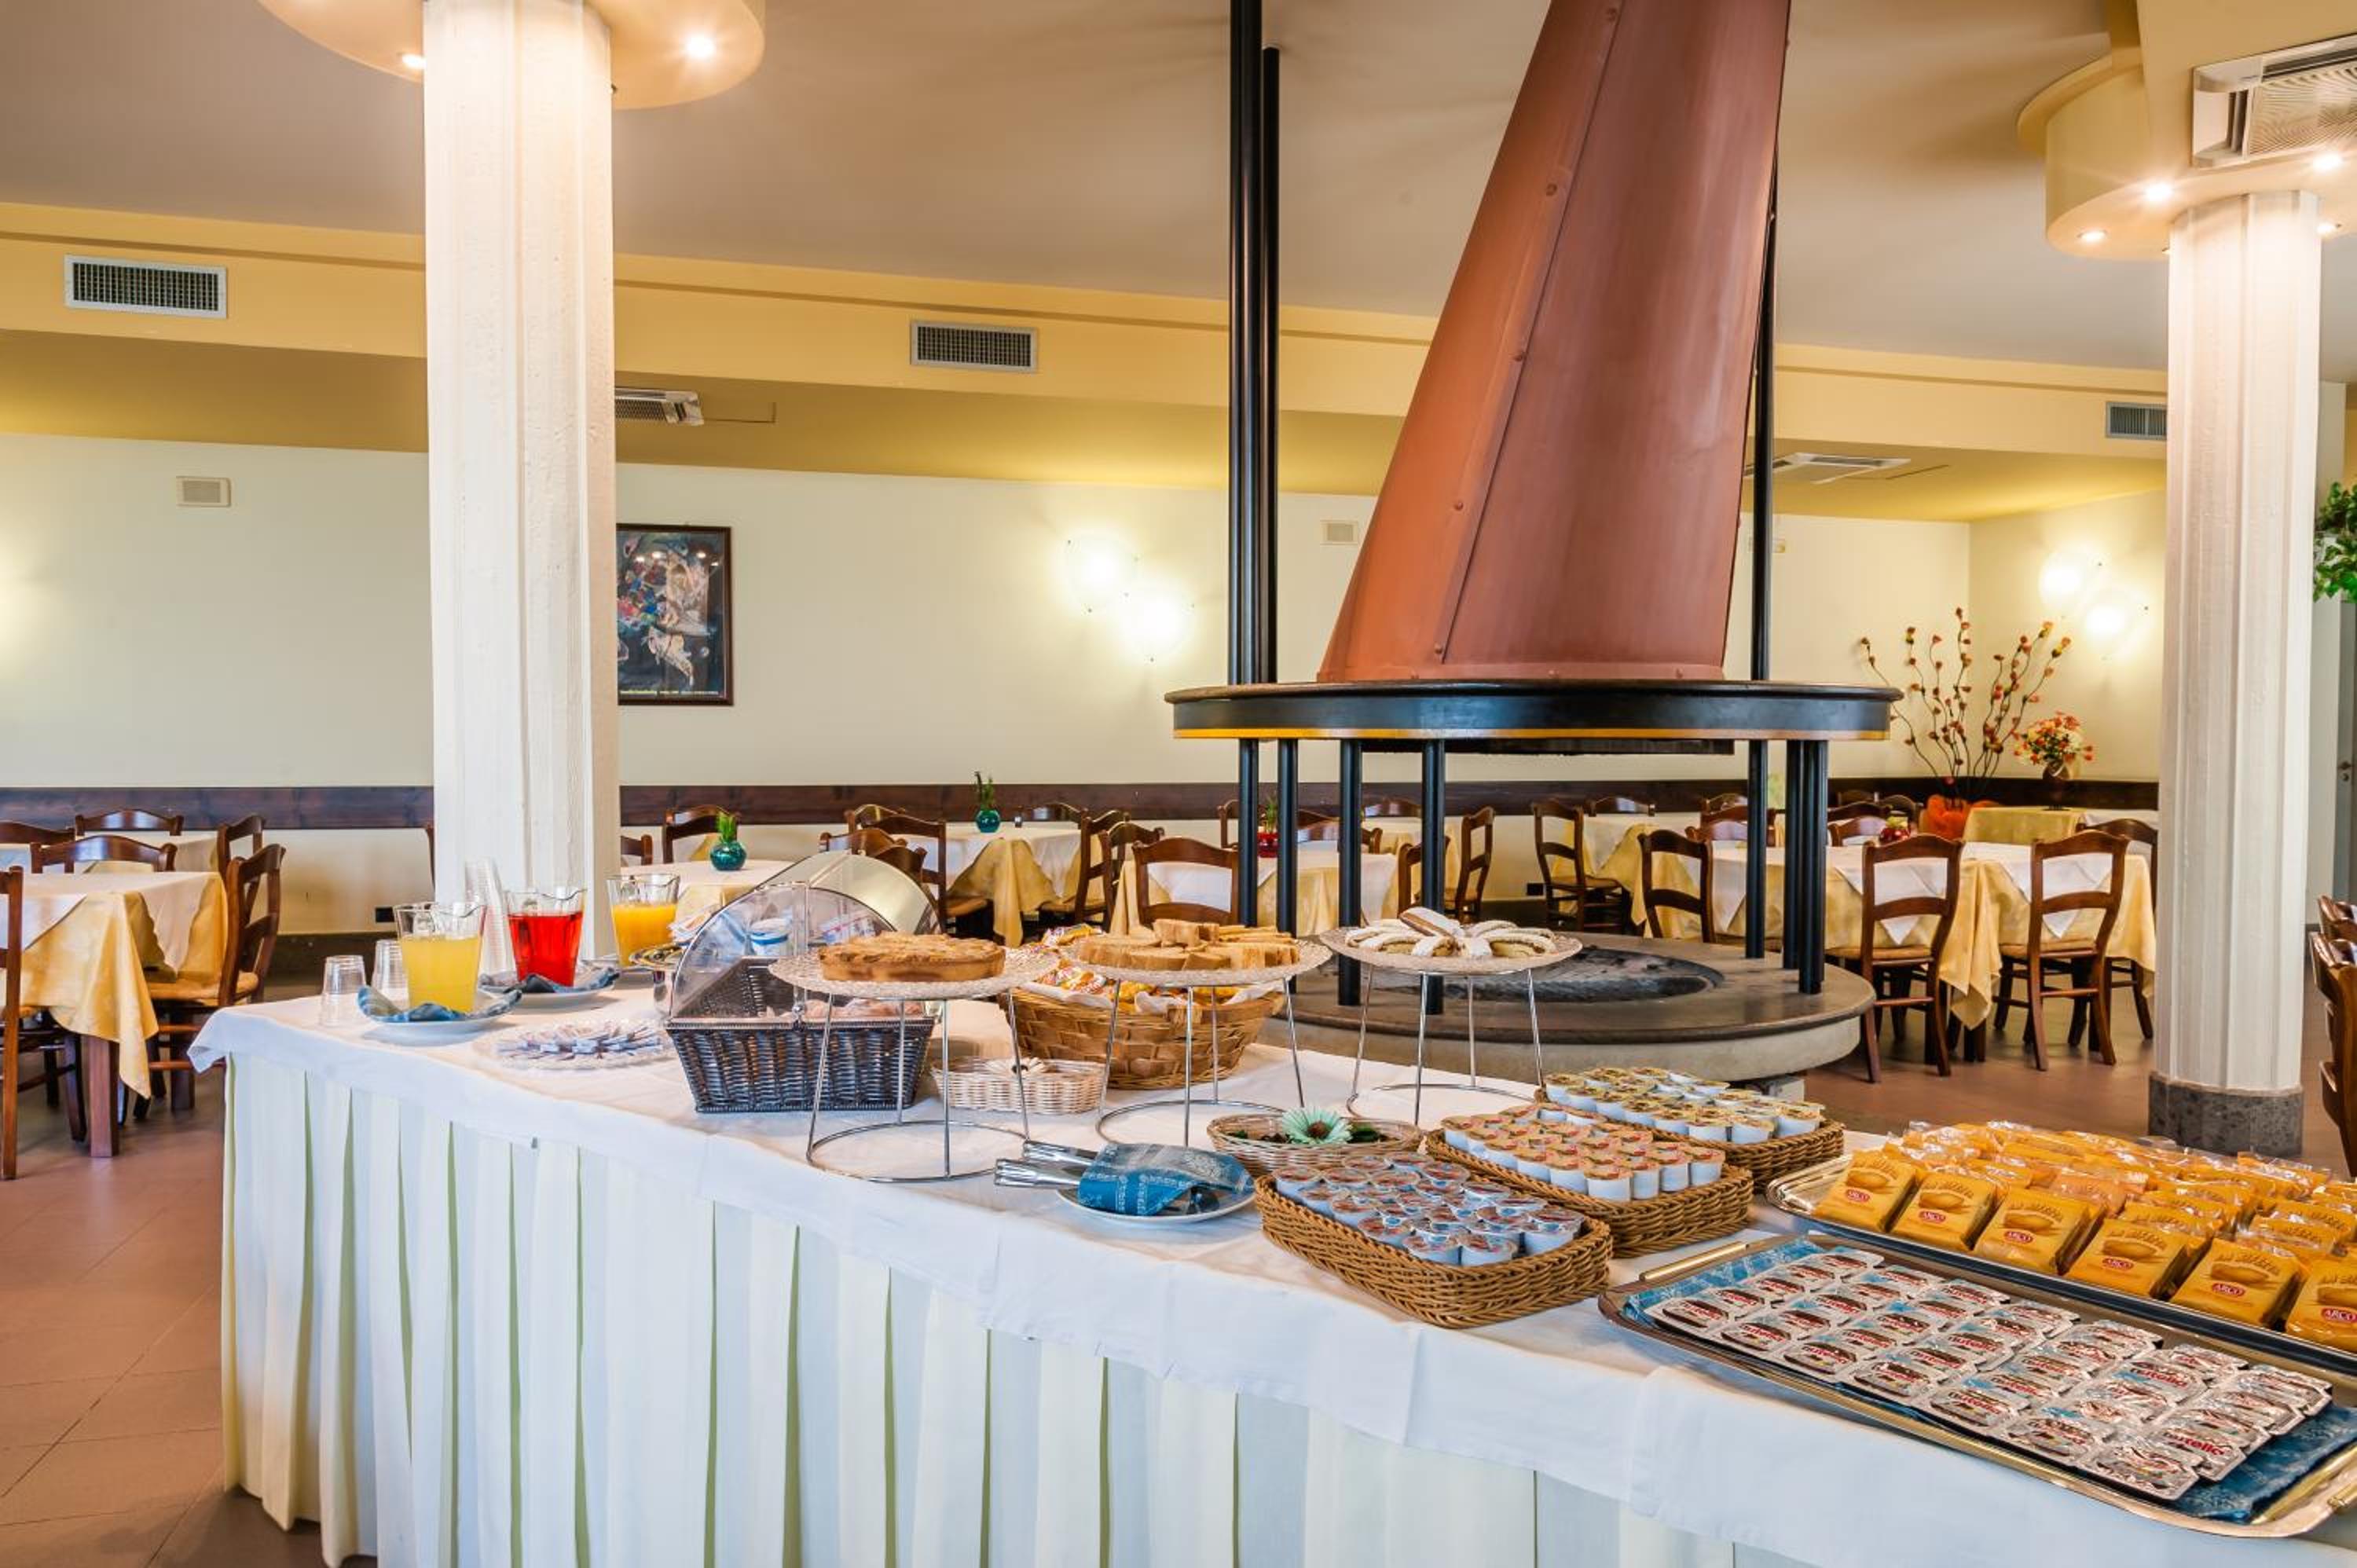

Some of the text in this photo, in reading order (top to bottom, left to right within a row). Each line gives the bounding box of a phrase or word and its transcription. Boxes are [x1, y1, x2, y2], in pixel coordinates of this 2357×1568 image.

[2214, 1284, 2245, 1297] ARCO
[2324, 1309, 2356, 1324] ARCO
[2131, 1368, 2188, 1388] nutella
[2163, 1431, 2225, 1456] nutella
